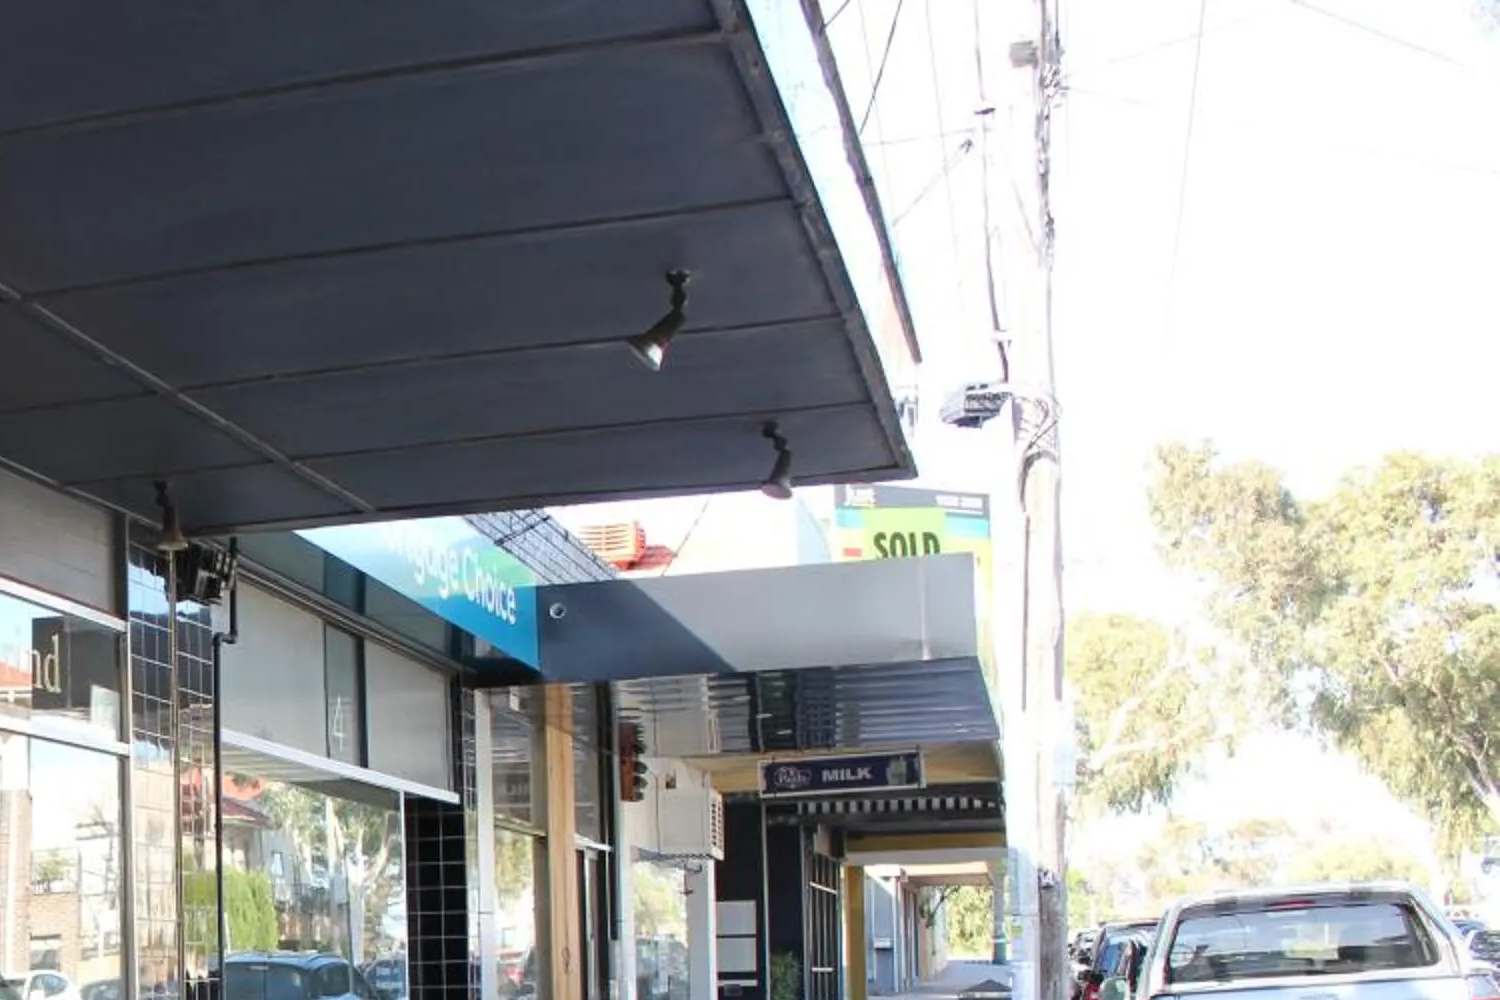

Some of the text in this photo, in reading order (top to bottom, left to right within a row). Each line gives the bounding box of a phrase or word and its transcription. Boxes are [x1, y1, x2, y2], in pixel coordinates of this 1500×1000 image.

[873, 531, 941, 559] SOLD
[463, 545, 517, 625] Choice
[821, 767, 874, 783] MILK
